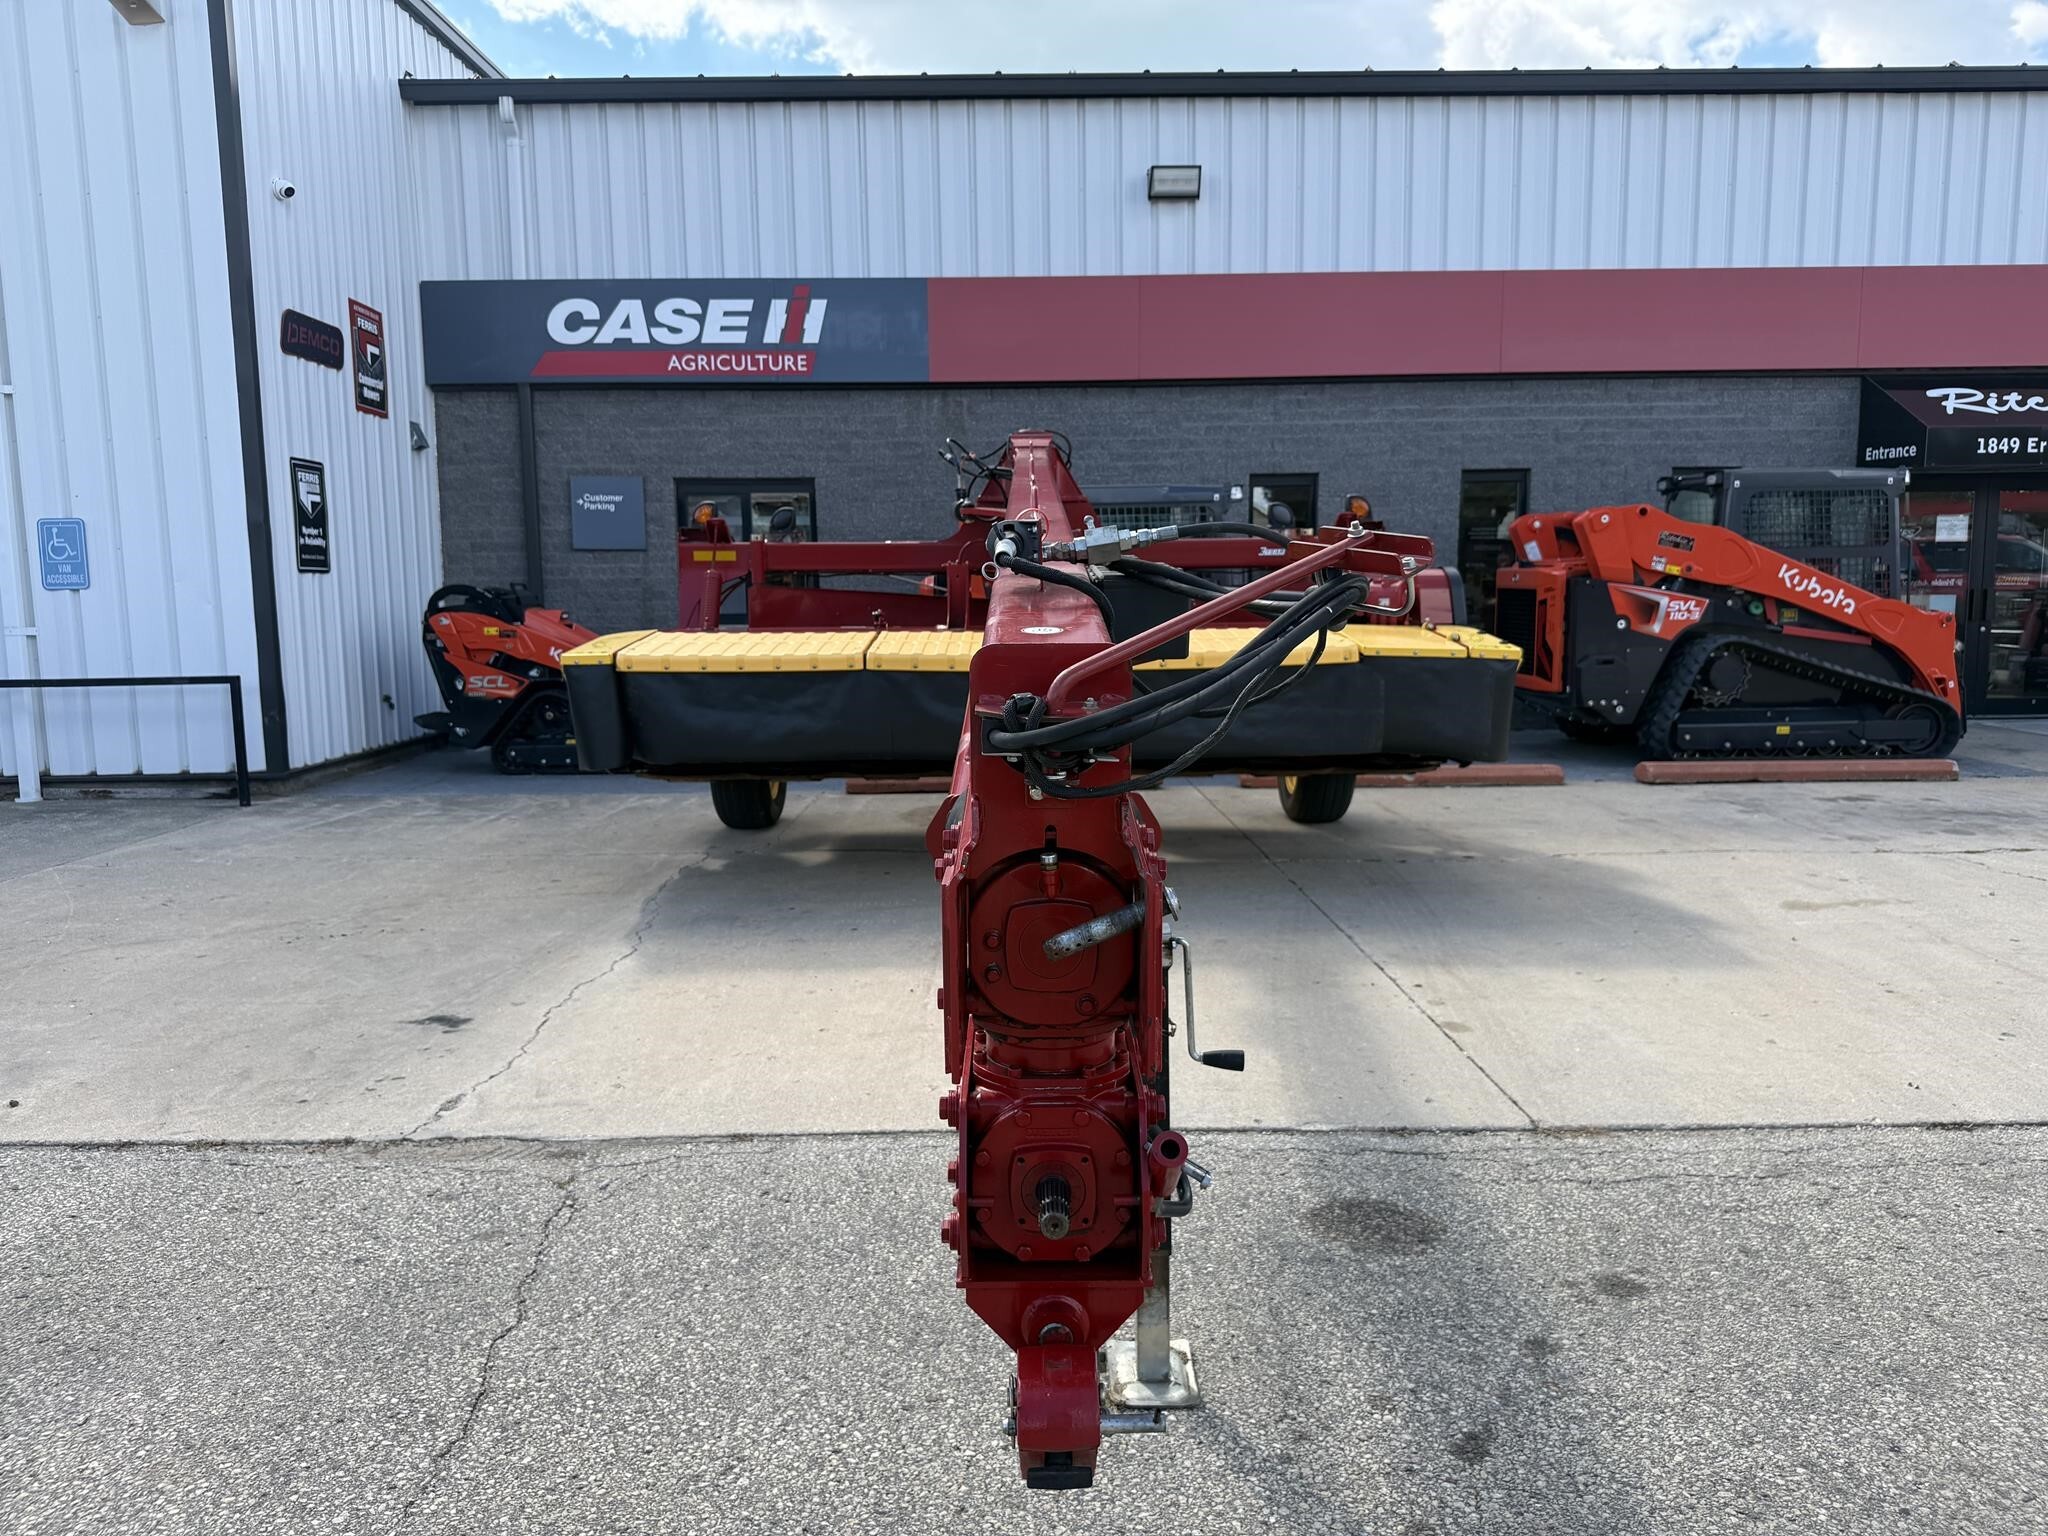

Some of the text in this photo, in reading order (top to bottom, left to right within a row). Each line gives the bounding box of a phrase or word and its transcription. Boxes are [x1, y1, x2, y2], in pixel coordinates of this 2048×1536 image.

[357, 317, 378, 336] FERRIS
[546, 297, 754, 345] CASE
[287, 323, 340, 357] DEMCO
[668, 354, 807, 372] AGRICULTURE
[1976, 437, 2020, 454] 1849
[1865, 444, 1917, 461] Entrance
[298, 471, 320, 485] FERRIS
[583, 493, 624, 503] Customer
[584, 502, 616, 513] Parking
[301, 525, 319, 537] Number
[305, 536, 326, 549] Reliability
[57, 564, 72, 573] VAN
[46, 574, 85, 584] ACCESSIBLE
[1777, 563, 1856, 615] Kubota
[1668, 600, 1701, 611] SVL
[1669, 610, 1700, 621] 110-3
[468, 675, 510, 688] SCL
